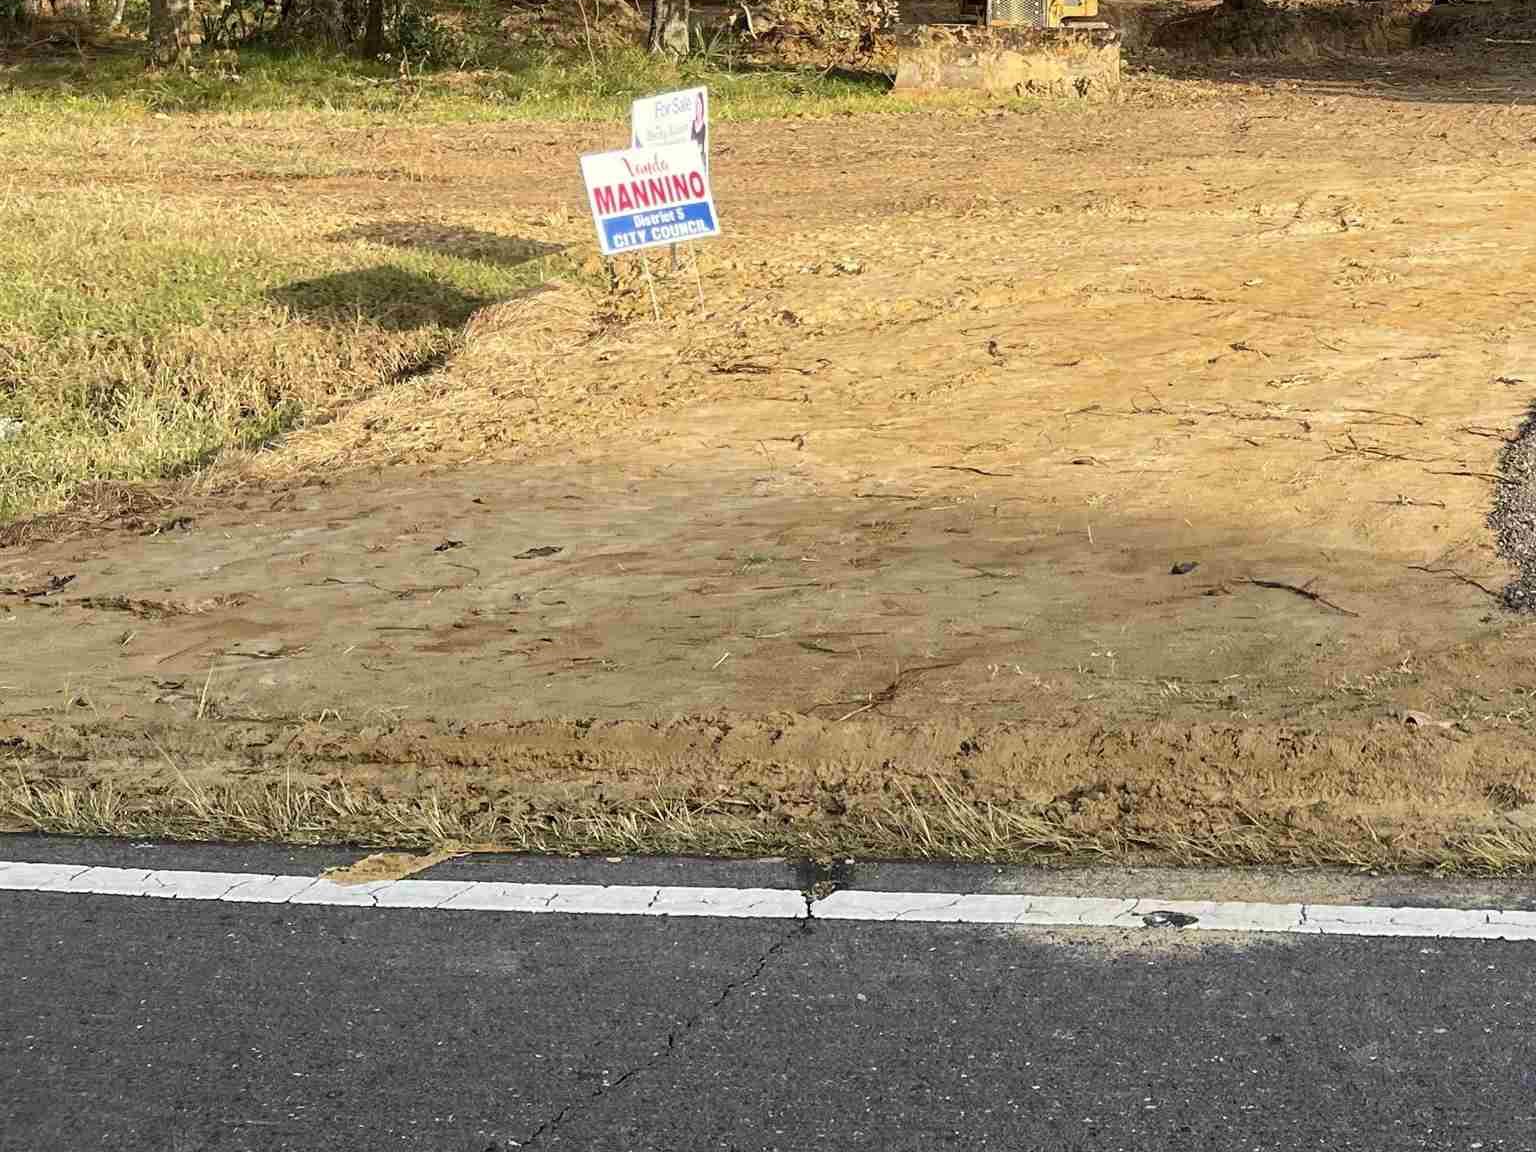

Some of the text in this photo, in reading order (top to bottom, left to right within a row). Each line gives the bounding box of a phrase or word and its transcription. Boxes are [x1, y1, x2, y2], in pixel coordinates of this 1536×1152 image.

[655, 96, 692, 119] For Sale
[593, 170, 705, 215] MANNINO
[633, 207, 685, 228] District 5
[612, 219, 711, 248] CITY COUNCIL
